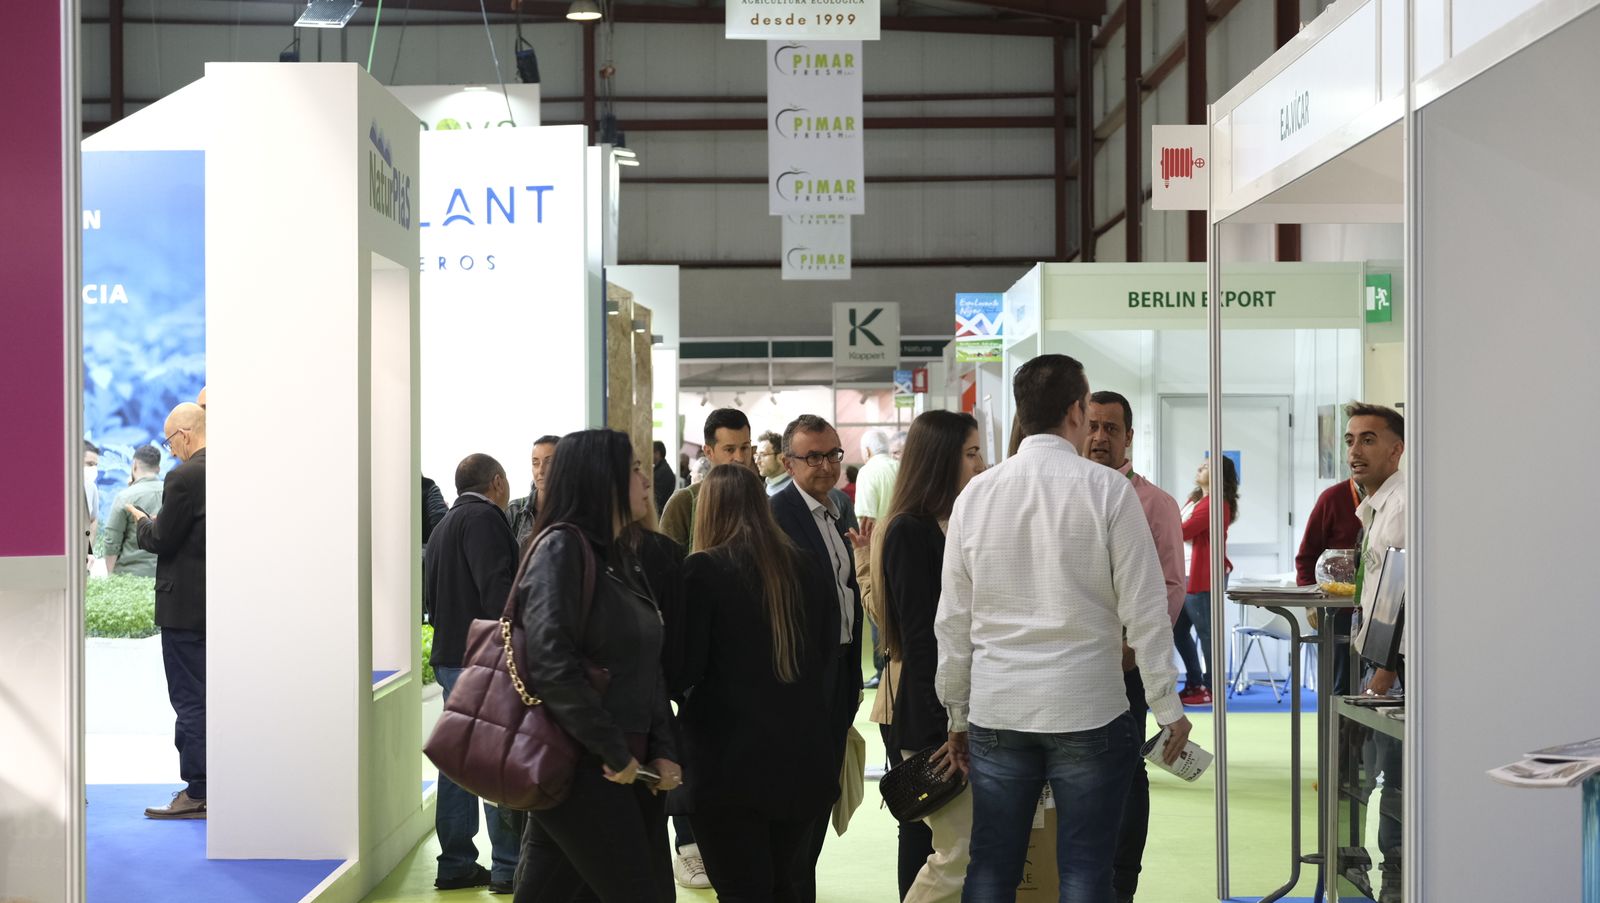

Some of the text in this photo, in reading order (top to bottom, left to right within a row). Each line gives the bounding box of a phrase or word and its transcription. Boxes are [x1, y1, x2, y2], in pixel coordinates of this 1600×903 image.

[751, 13, 856, 26] desde 1999
[793, 54, 854, 69] PIMAR
[794, 116, 855, 131] PIMAR
[795, 179, 856, 194] PIMAR
[800, 253, 846, 266] PIMAR
[1128, 290, 1277, 308] BERLIN EPORT
[848, 308, 885, 347] K
[849, 351, 886, 361] Koppert
